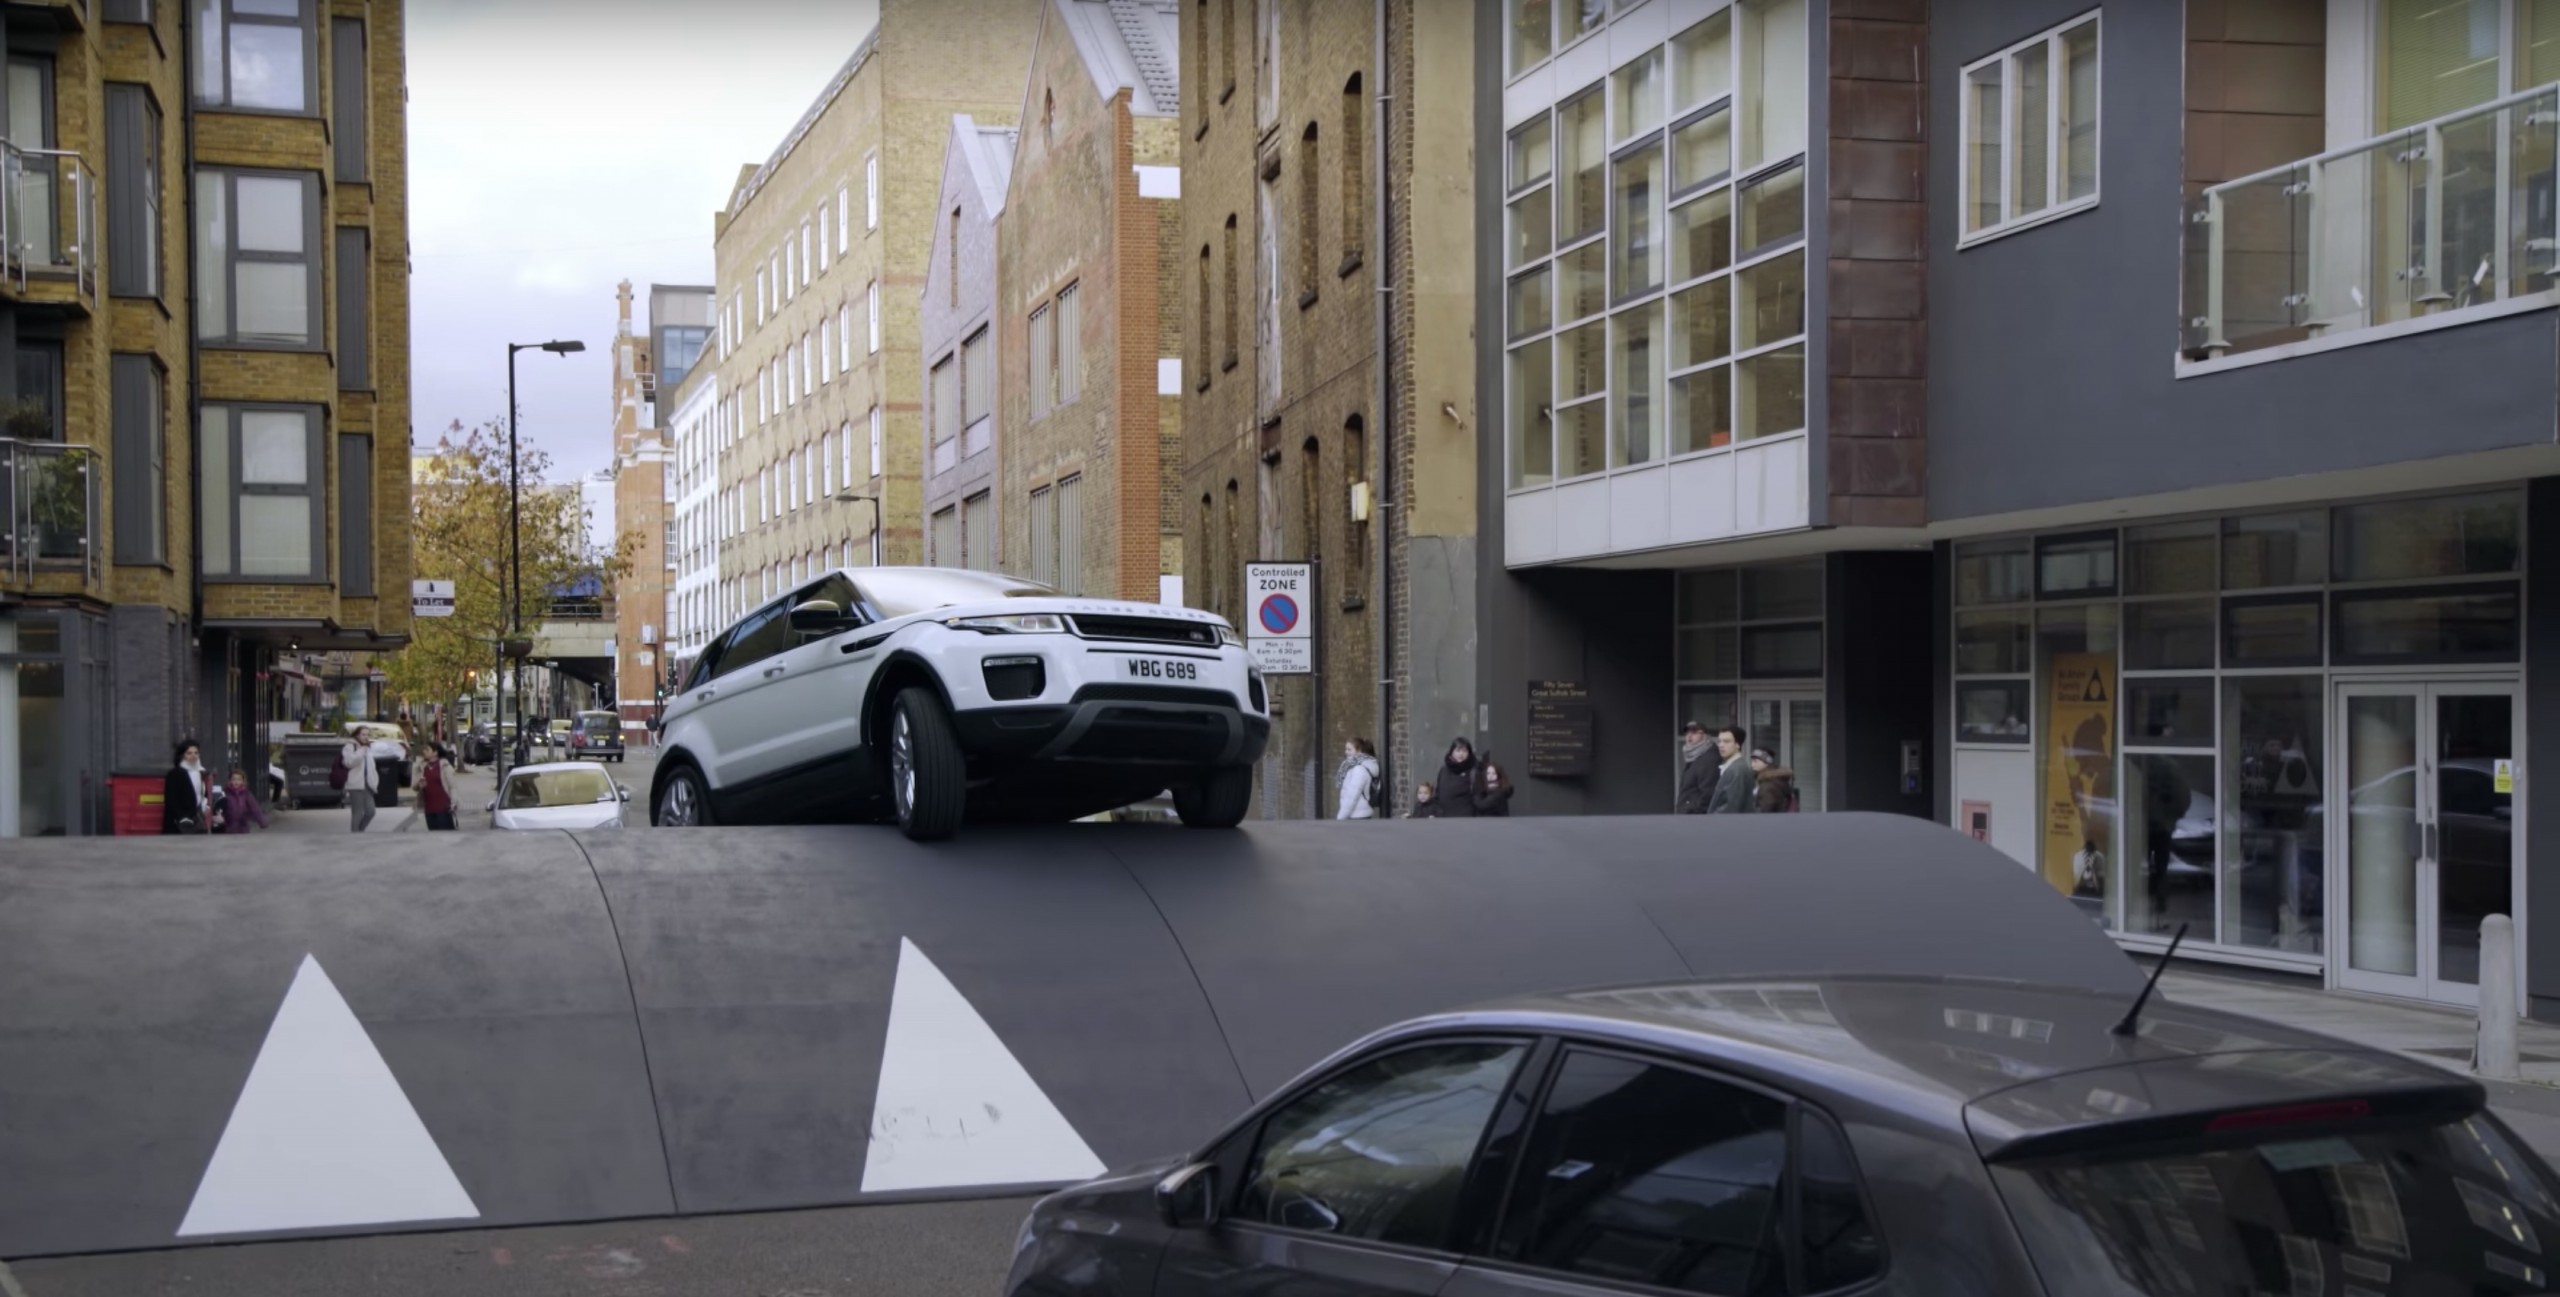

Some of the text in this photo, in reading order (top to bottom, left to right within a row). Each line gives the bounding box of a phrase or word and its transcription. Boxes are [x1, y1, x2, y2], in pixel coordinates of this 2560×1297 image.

[1251, 567, 1305, 577] Controlled
[1259, 579, 1297, 590] ZONE
[416, 597, 444, 606] To Let
[1128, 659, 1197, 680] WBG 689
